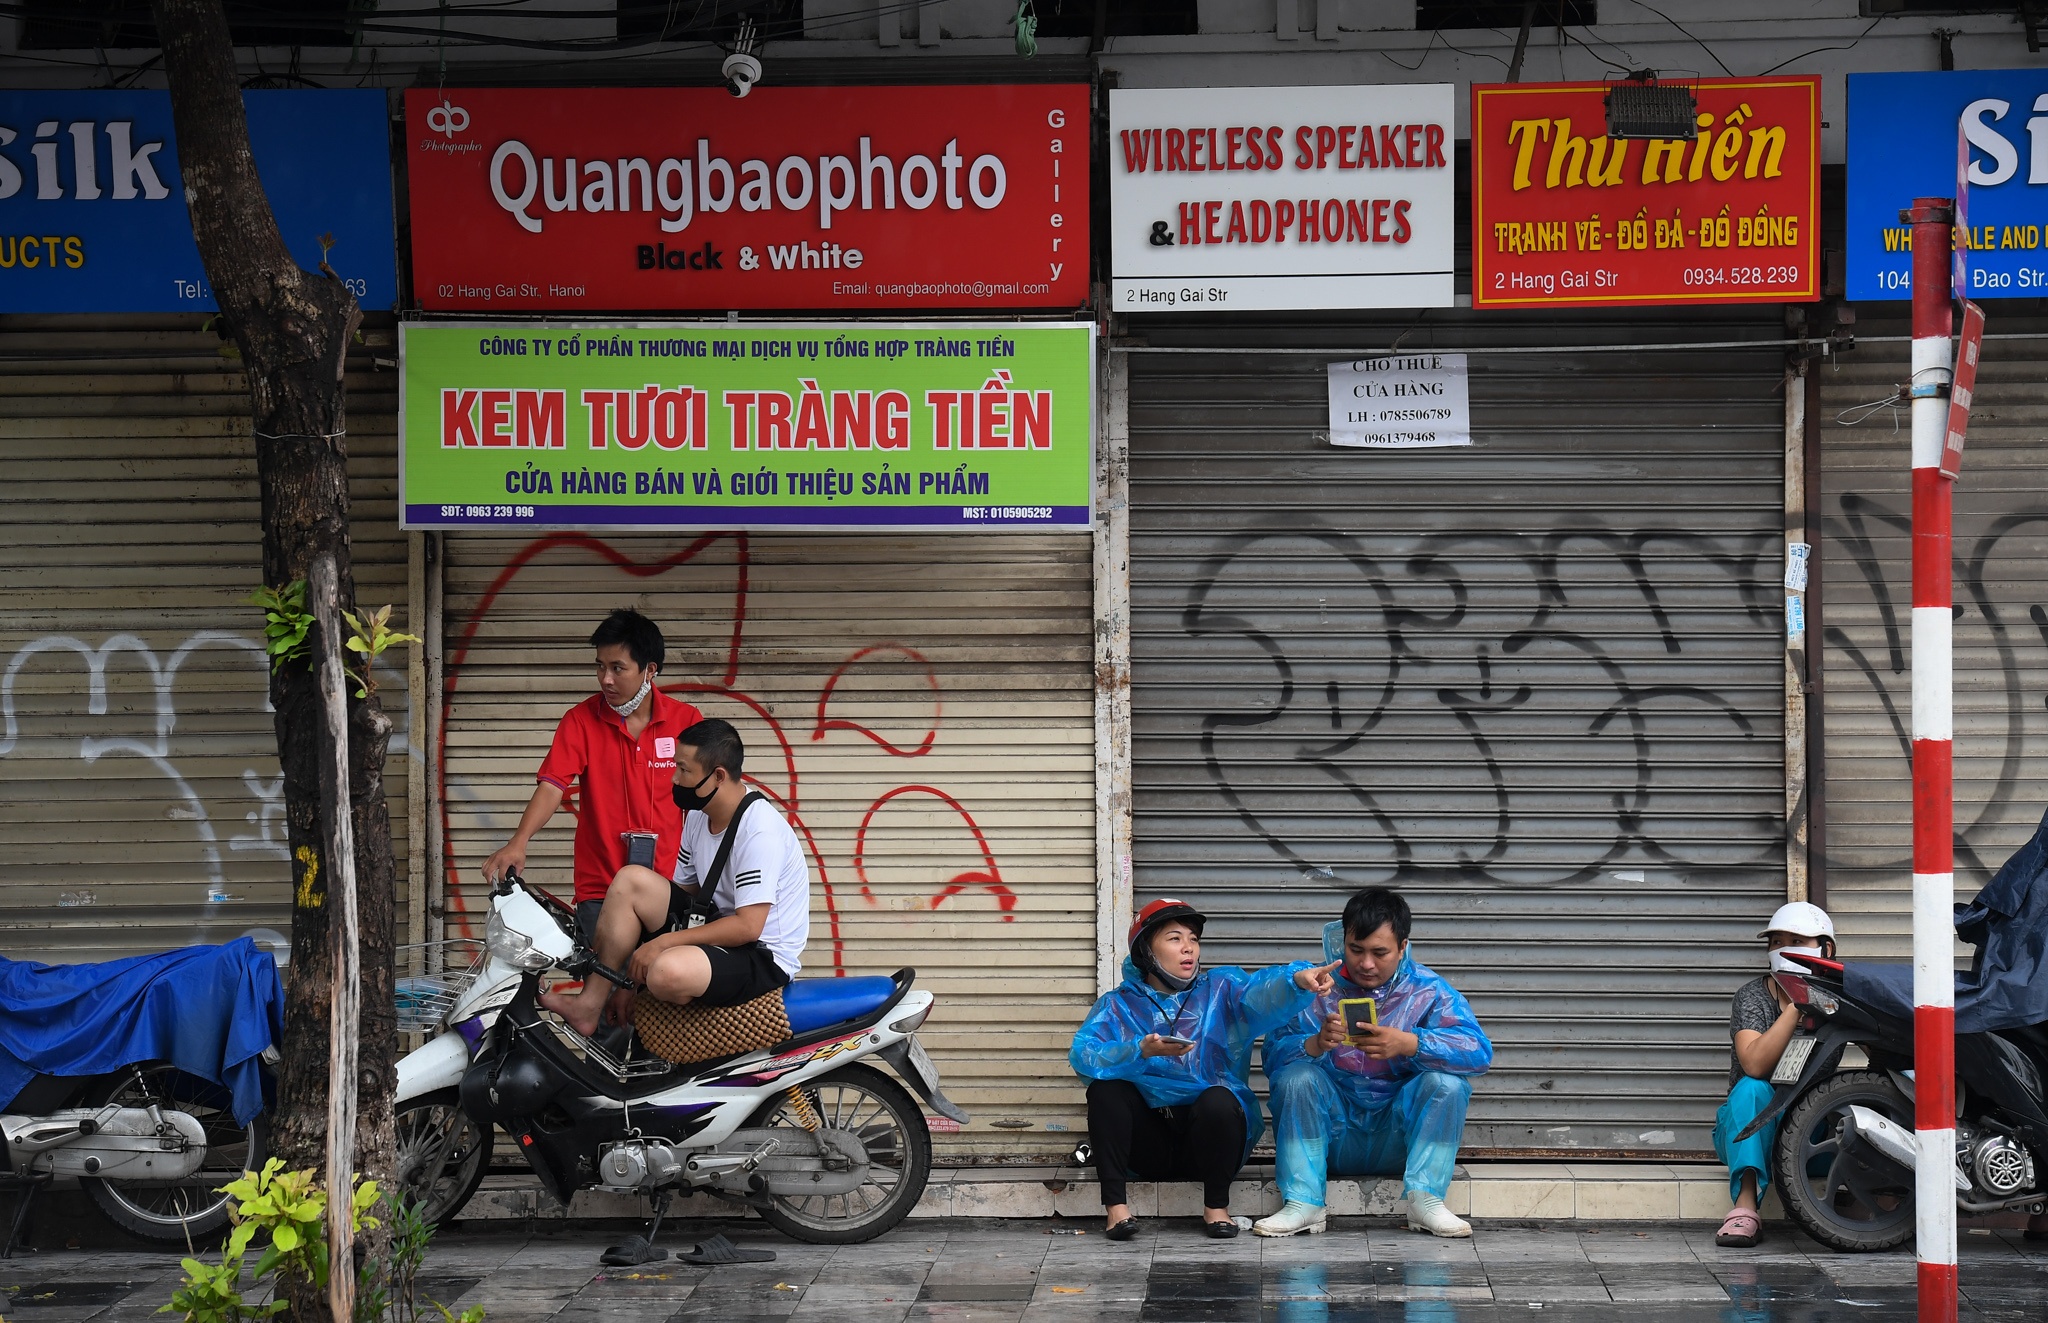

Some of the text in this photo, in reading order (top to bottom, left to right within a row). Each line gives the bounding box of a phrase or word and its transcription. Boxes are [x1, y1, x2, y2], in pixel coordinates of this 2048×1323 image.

[421, 140, 482, 156] Photographer
[1120, 124, 1446, 173] WIRELESS SPEAKER
[490, 136, 1007, 233] Quangbaophoto
[1047, 109, 1066, 281] Gallery
[1494, 222, 1567, 256] TRANH
[1738, 203, 1798, 247] ĐỒNG
[2001, 226, 2039, 249] AND
[637, 241, 864, 271] Black & White
[1495, 269, 1618, 293] 2 Hang Gai Str
[1684, 267, 1798, 285] 0934.528.239
[1877, 271, 1910, 289] 104
[174, 280, 208, 298] Tel:
[438, 285, 453, 297] 02
[458, 285, 491, 300] Hang
[495, 284, 516, 297] Gai
[550, 284, 585, 297] Hanoi
[833, 281, 1049, 297] Email: quangbaophoto@gmail.com
[1127, 288, 1228, 305] 2 Hang Gai Str
[479, 333, 1014, 361] CÔNG TY CỔ PHẦN THƯƠNG MẠI DỊCH VỤ TỔNG HỢP TRÀNG TIỀN
[1353, 380, 1443, 398] CỬA HÀNG
[441, 369, 1052, 451] KEM TƯƠI TRÀNG TIỀN
[1348, 412, 1367, 422] LH
[1380, 408, 1451, 421] 0785506789
[1365, 432, 1435, 444] 0961379468
[506, 461, 989, 500] CỬA HÀNG BÁN VÀ GIỚI THIỆU SẢN PHẨM
[441, 506, 534, 518] SĐT: 0963 239 996
[963, 507, 1052, 519] MST: 0105905292
[296, 845, 326, 909] 2
